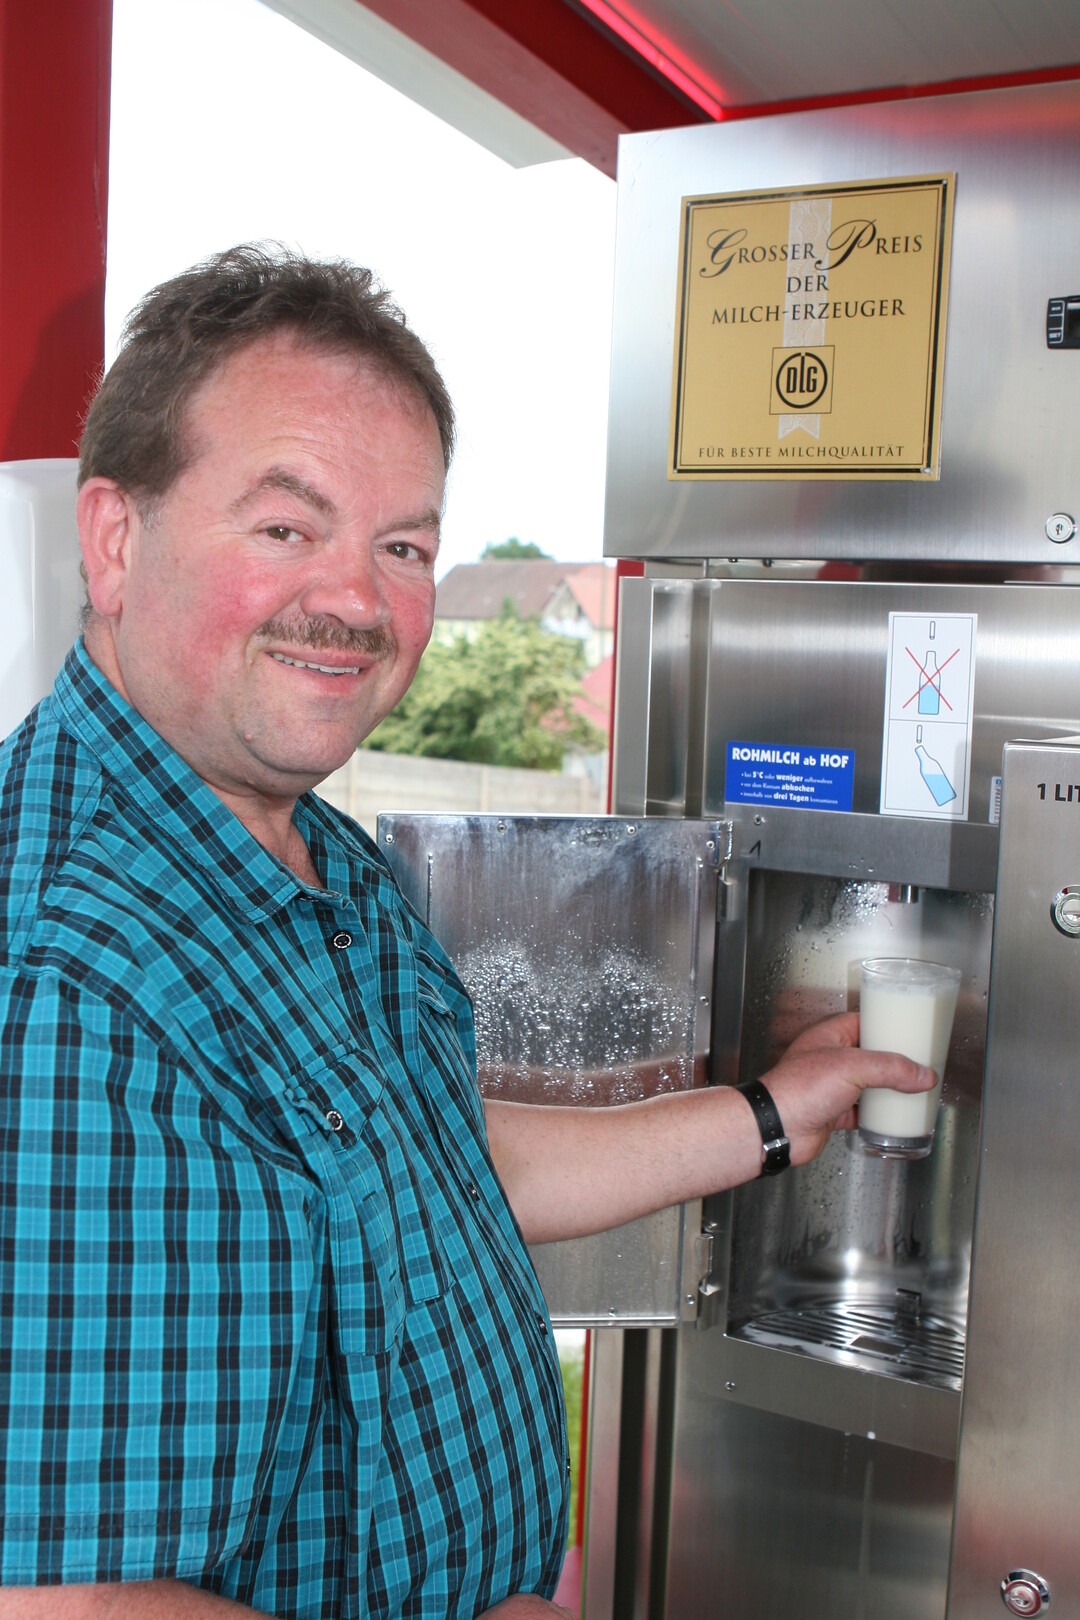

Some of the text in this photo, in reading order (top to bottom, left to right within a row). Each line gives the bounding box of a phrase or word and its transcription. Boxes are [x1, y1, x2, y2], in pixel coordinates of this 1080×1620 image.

[699, 219, 923, 278] GROSSER PREIS
[786, 275, 829, 293] DER
[711, 298, 906, 324] MILCH-ERZEUGER
[698, 444, 905, 459] FÜR BESTE MILCHQUALITÄT
[732, 747, 849, 768] ROHMILCH ab HOF
[776, 773, 804, 783] weniger
[781, 783, 815, 793] abkochen
[1037, 783, 1046, 800] 1
[773, 791, 788, 800] drei
[789, 793, 809, 803] Tagen
